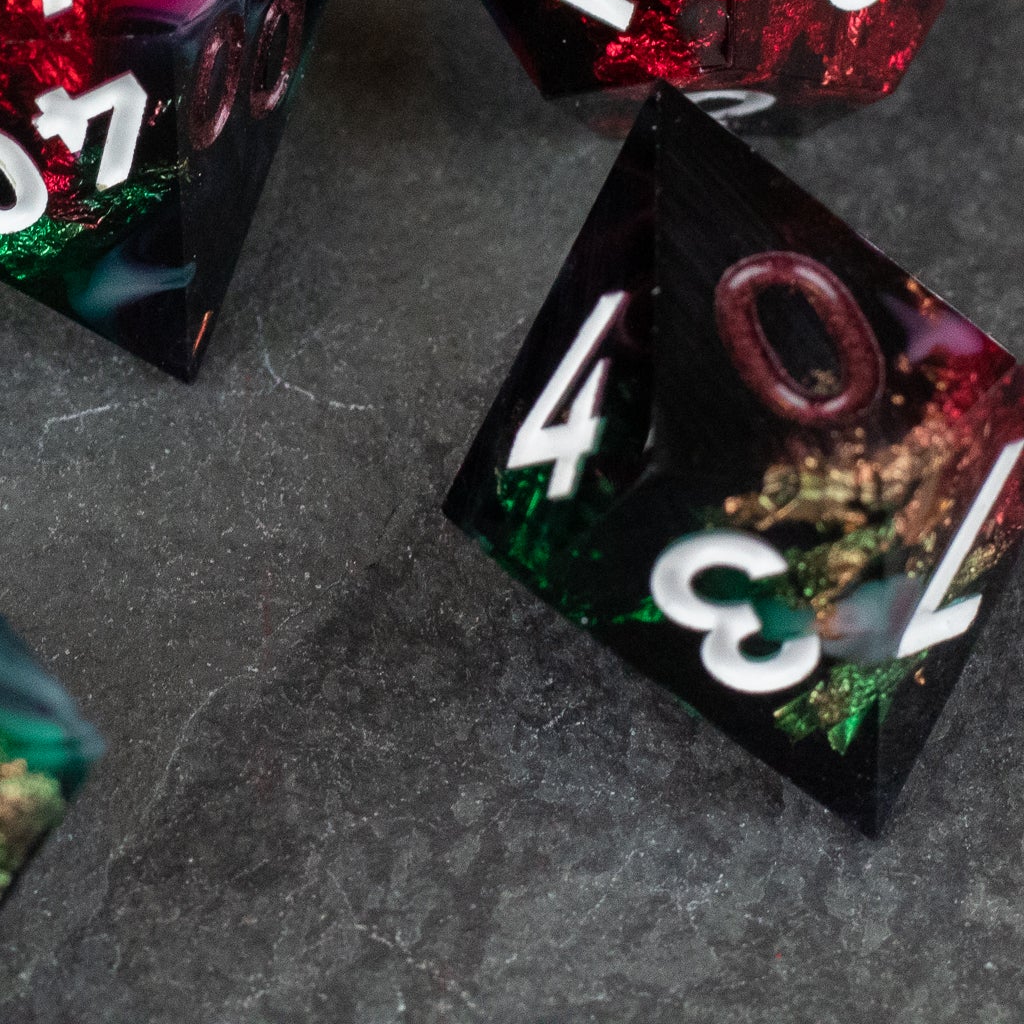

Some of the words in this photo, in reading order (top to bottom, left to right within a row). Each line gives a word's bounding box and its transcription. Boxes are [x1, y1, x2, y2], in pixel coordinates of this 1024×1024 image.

[505, 290, 631, 501] 4
[715, 250, 885, 424] 0
[650, 529, 822, 695] 3
